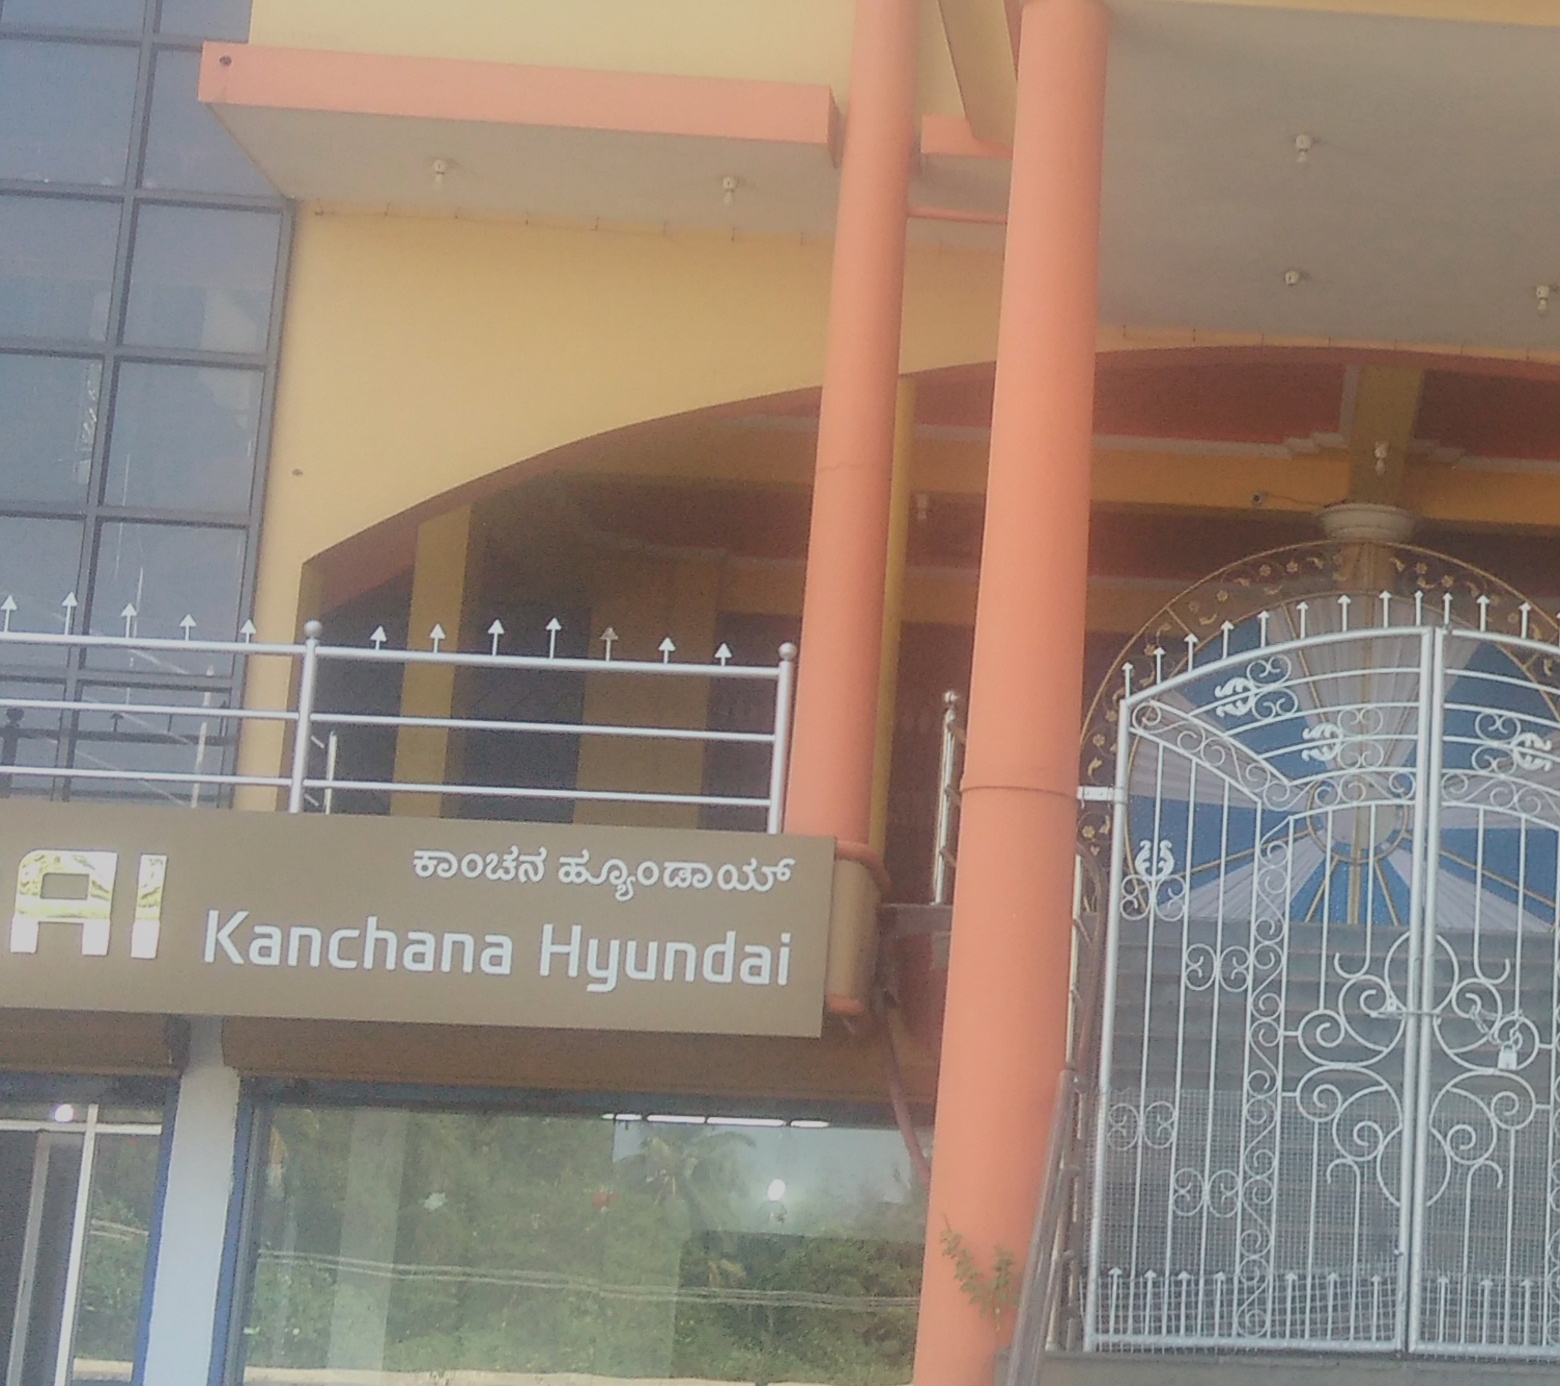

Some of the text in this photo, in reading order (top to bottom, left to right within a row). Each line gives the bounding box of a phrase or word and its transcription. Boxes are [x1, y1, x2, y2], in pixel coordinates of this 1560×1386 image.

[412, 845, 548, 884] ಕಾಂಚನ
[203, 910, 793, 993] Kanchana Hyundai
